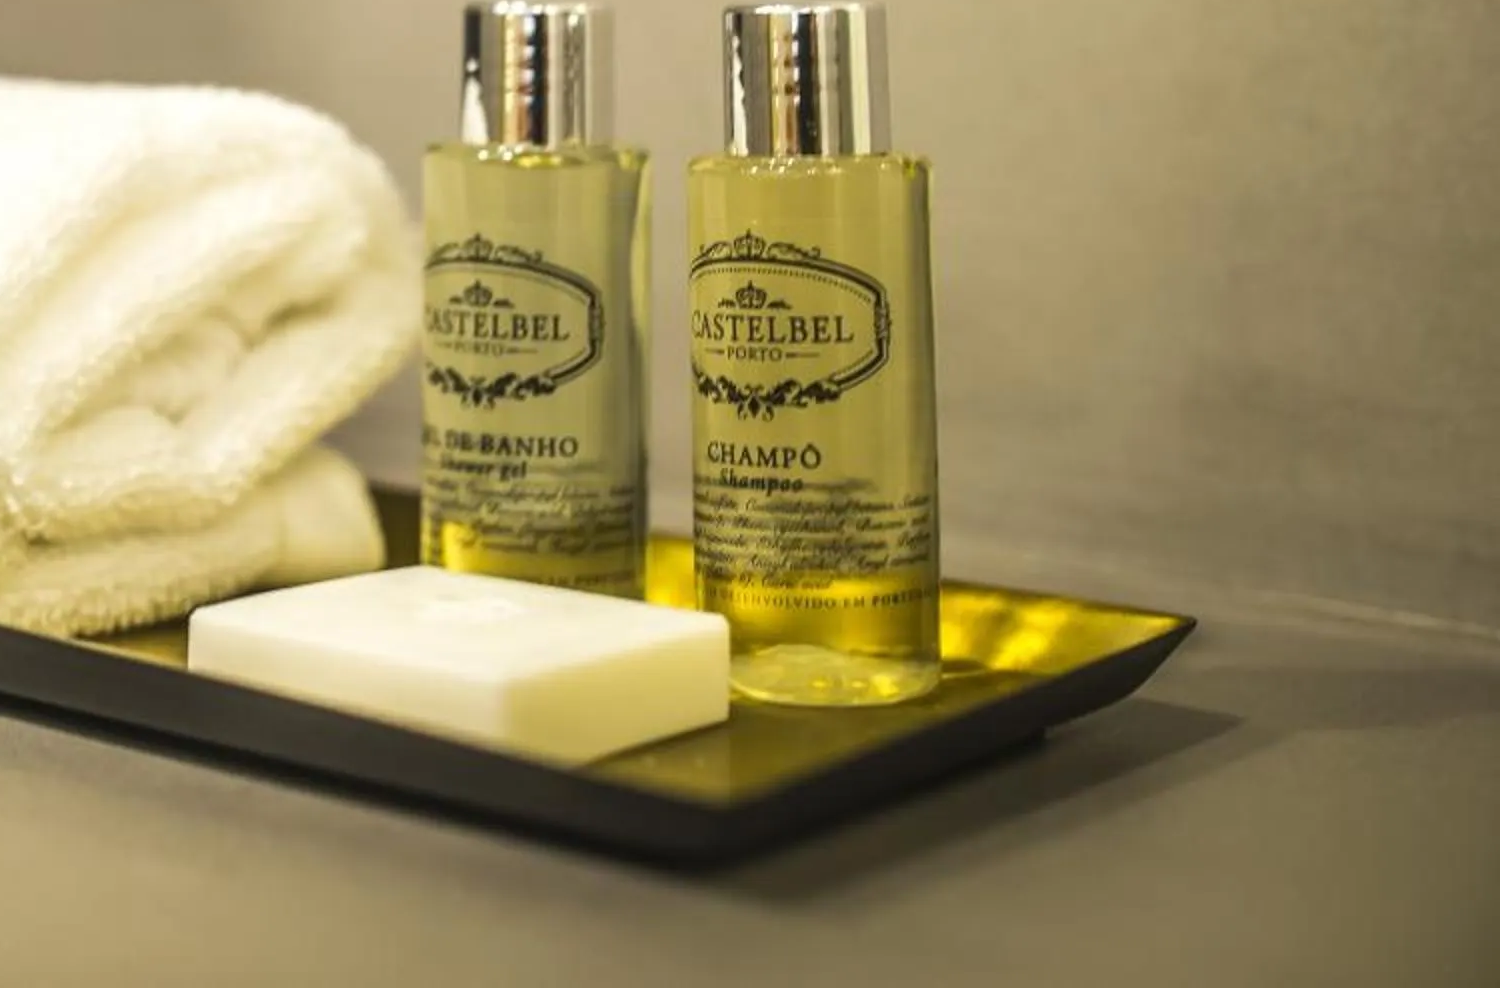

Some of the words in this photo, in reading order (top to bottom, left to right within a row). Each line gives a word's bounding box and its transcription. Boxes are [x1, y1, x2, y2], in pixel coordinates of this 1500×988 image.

[691, 311, 855, 344] CASTELBEL
[453, 341, 504, 357] PORTO
[726, 345, 783, 362] PORTO
[445, 428, 473, 452] DE
[480, 432, 579, 458] BANHO
[707, 440, 822, 469] CHAMPÔ
[499, 460, 527, 482] gel
[719, 468, 804, 496] Shampoo
